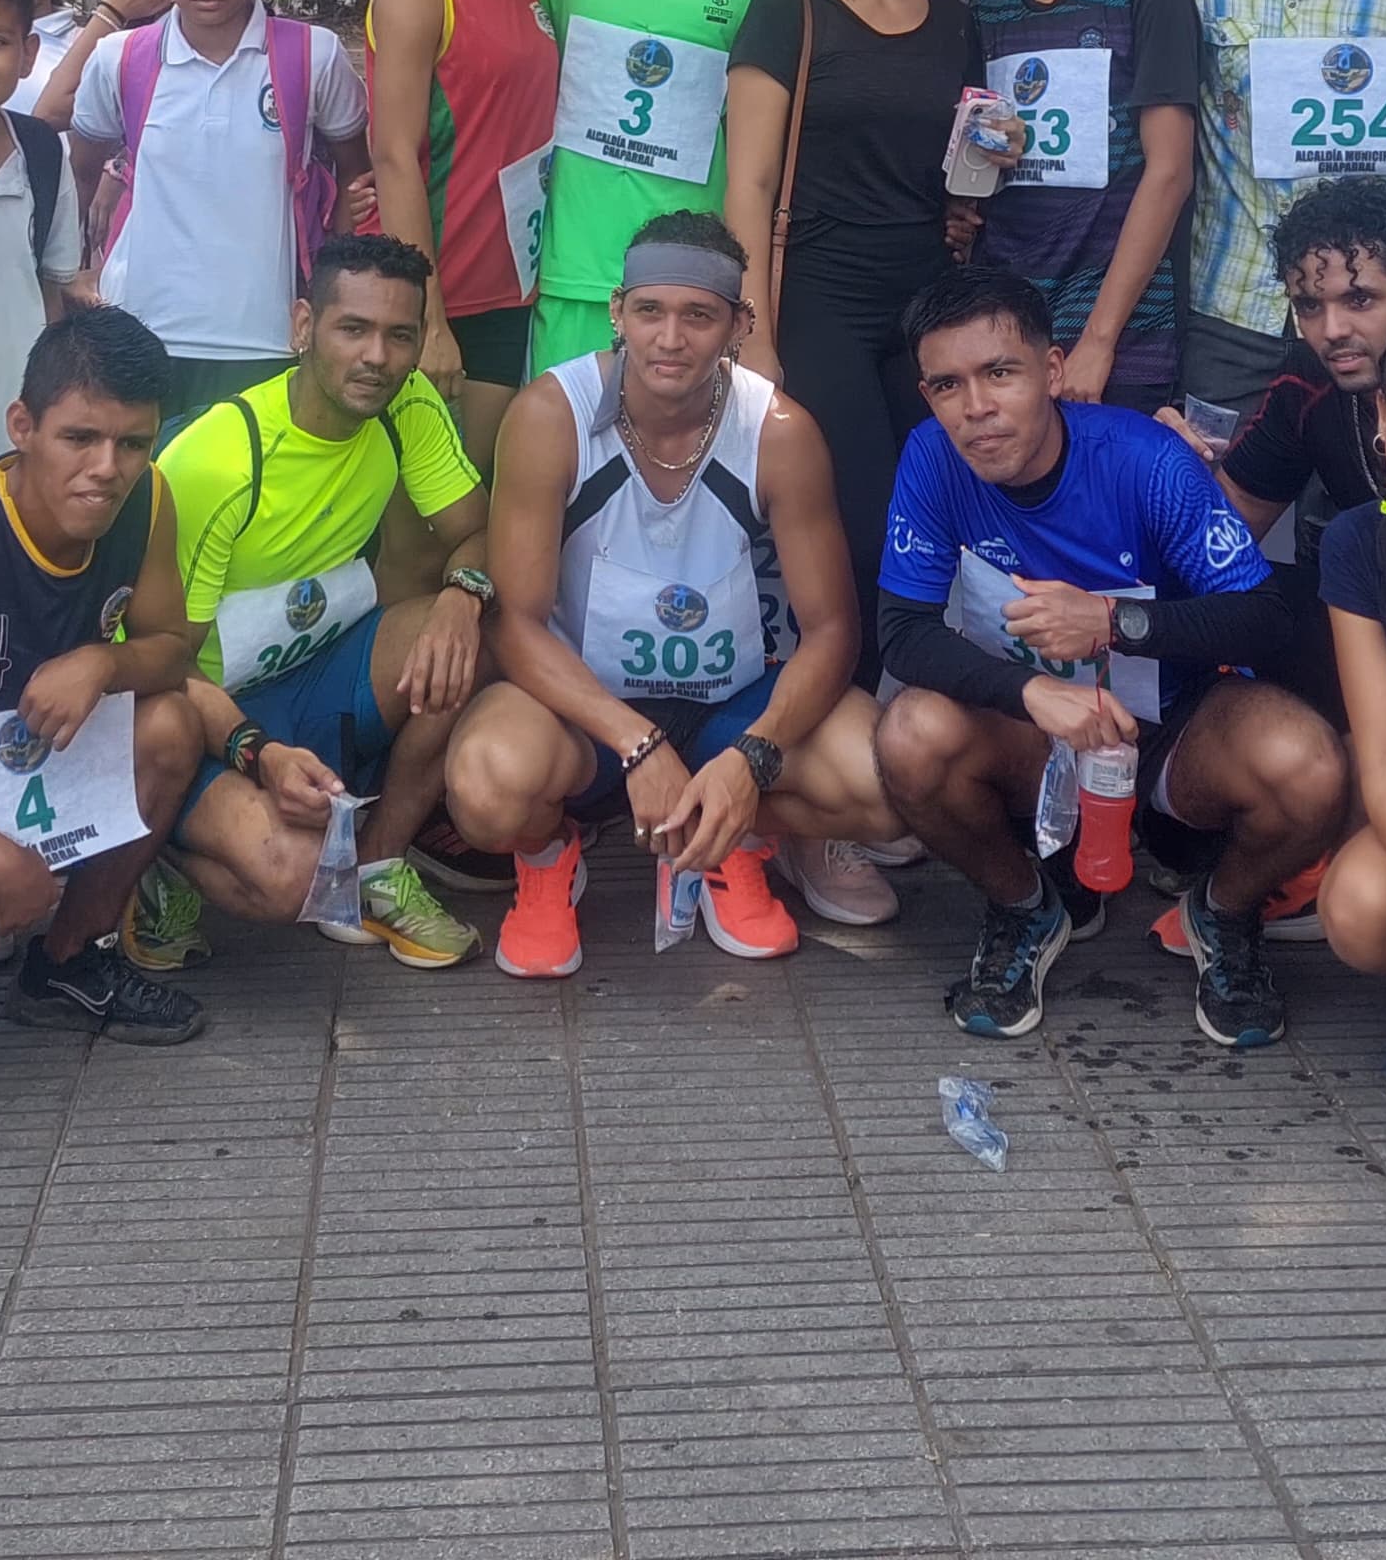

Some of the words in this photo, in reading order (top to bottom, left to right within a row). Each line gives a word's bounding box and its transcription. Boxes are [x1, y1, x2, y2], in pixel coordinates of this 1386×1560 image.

[618, 88, 655, 137] 3
[585, 128, 626, 149] ALCALDÍA
[627, 138, 679, 161] MUNICIPAL
[602, 144, 656, 168] CHAPARRAL
[1295, 148, 1344, 163] ALCALDÍA
[1318, 161, 1376, 173] CHAPARRAL
[620, 628, 736, 680] 303
[675, 675, 734, 691] MUNICIPAL
[15, 773, 58, 834] 4
[39, 823, 99, 855] MUNICIPAL
